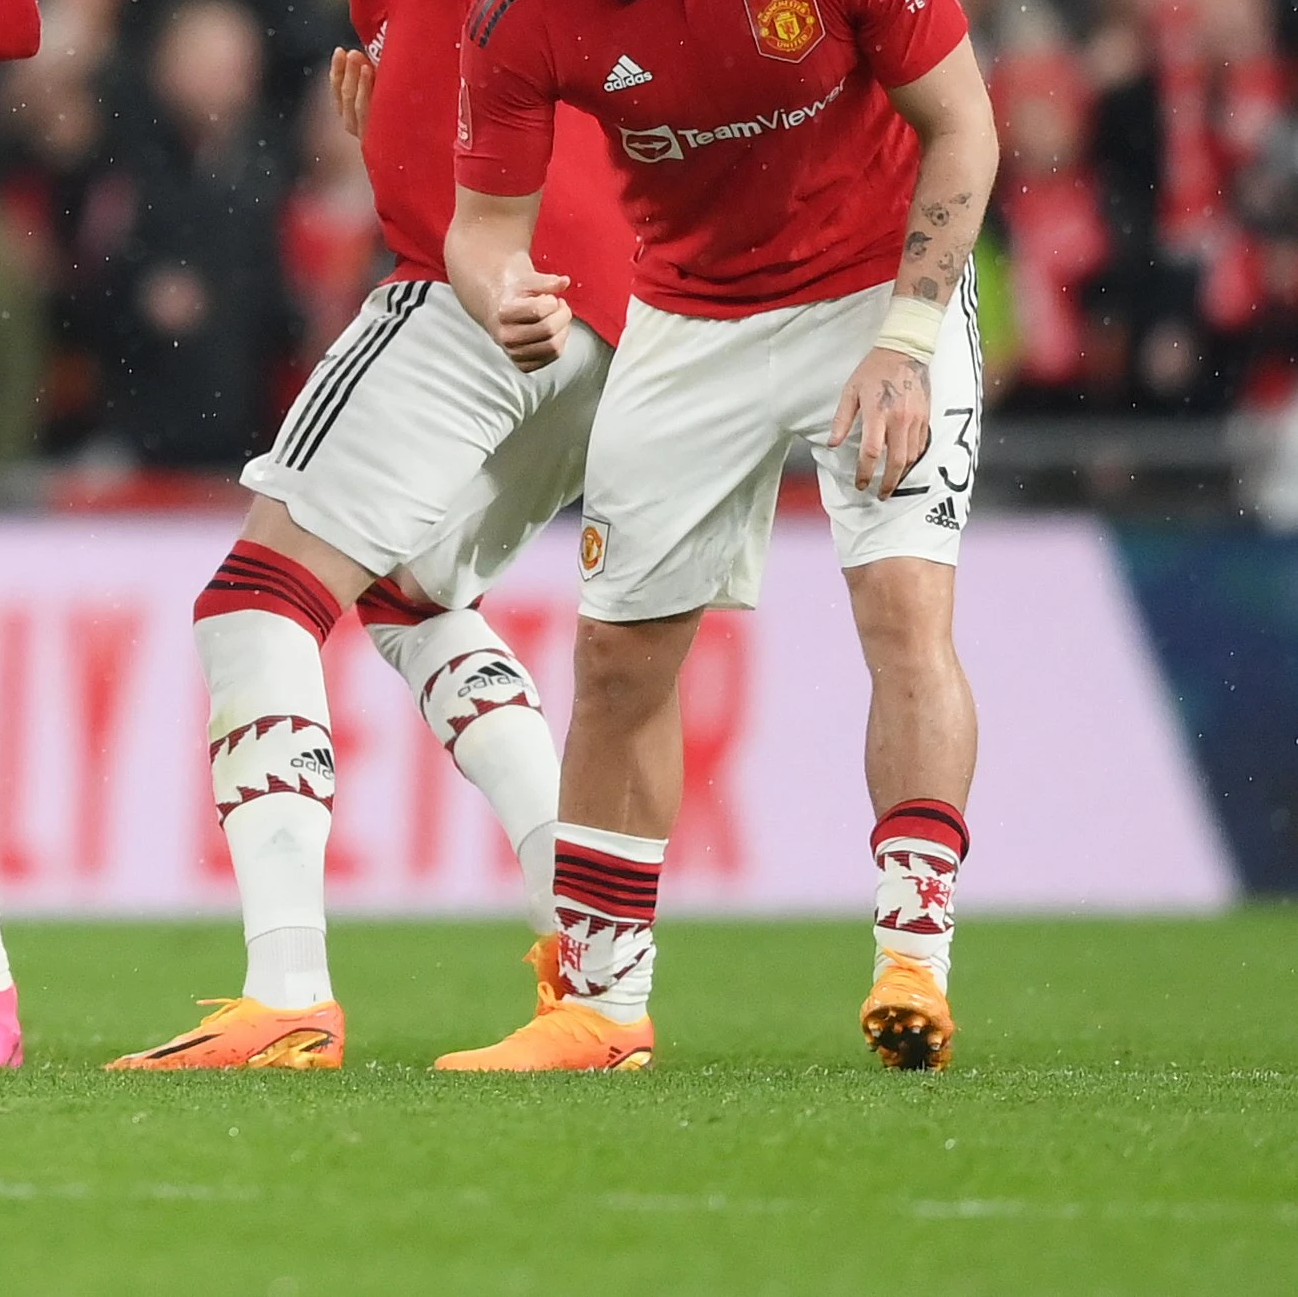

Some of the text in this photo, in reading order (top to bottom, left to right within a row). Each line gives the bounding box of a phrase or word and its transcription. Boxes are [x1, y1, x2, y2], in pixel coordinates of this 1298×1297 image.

[603, 71, 653, 93] adidas
[677, 77, 846, 149] TeamViewer
[290, 757, 334, 781] adid
